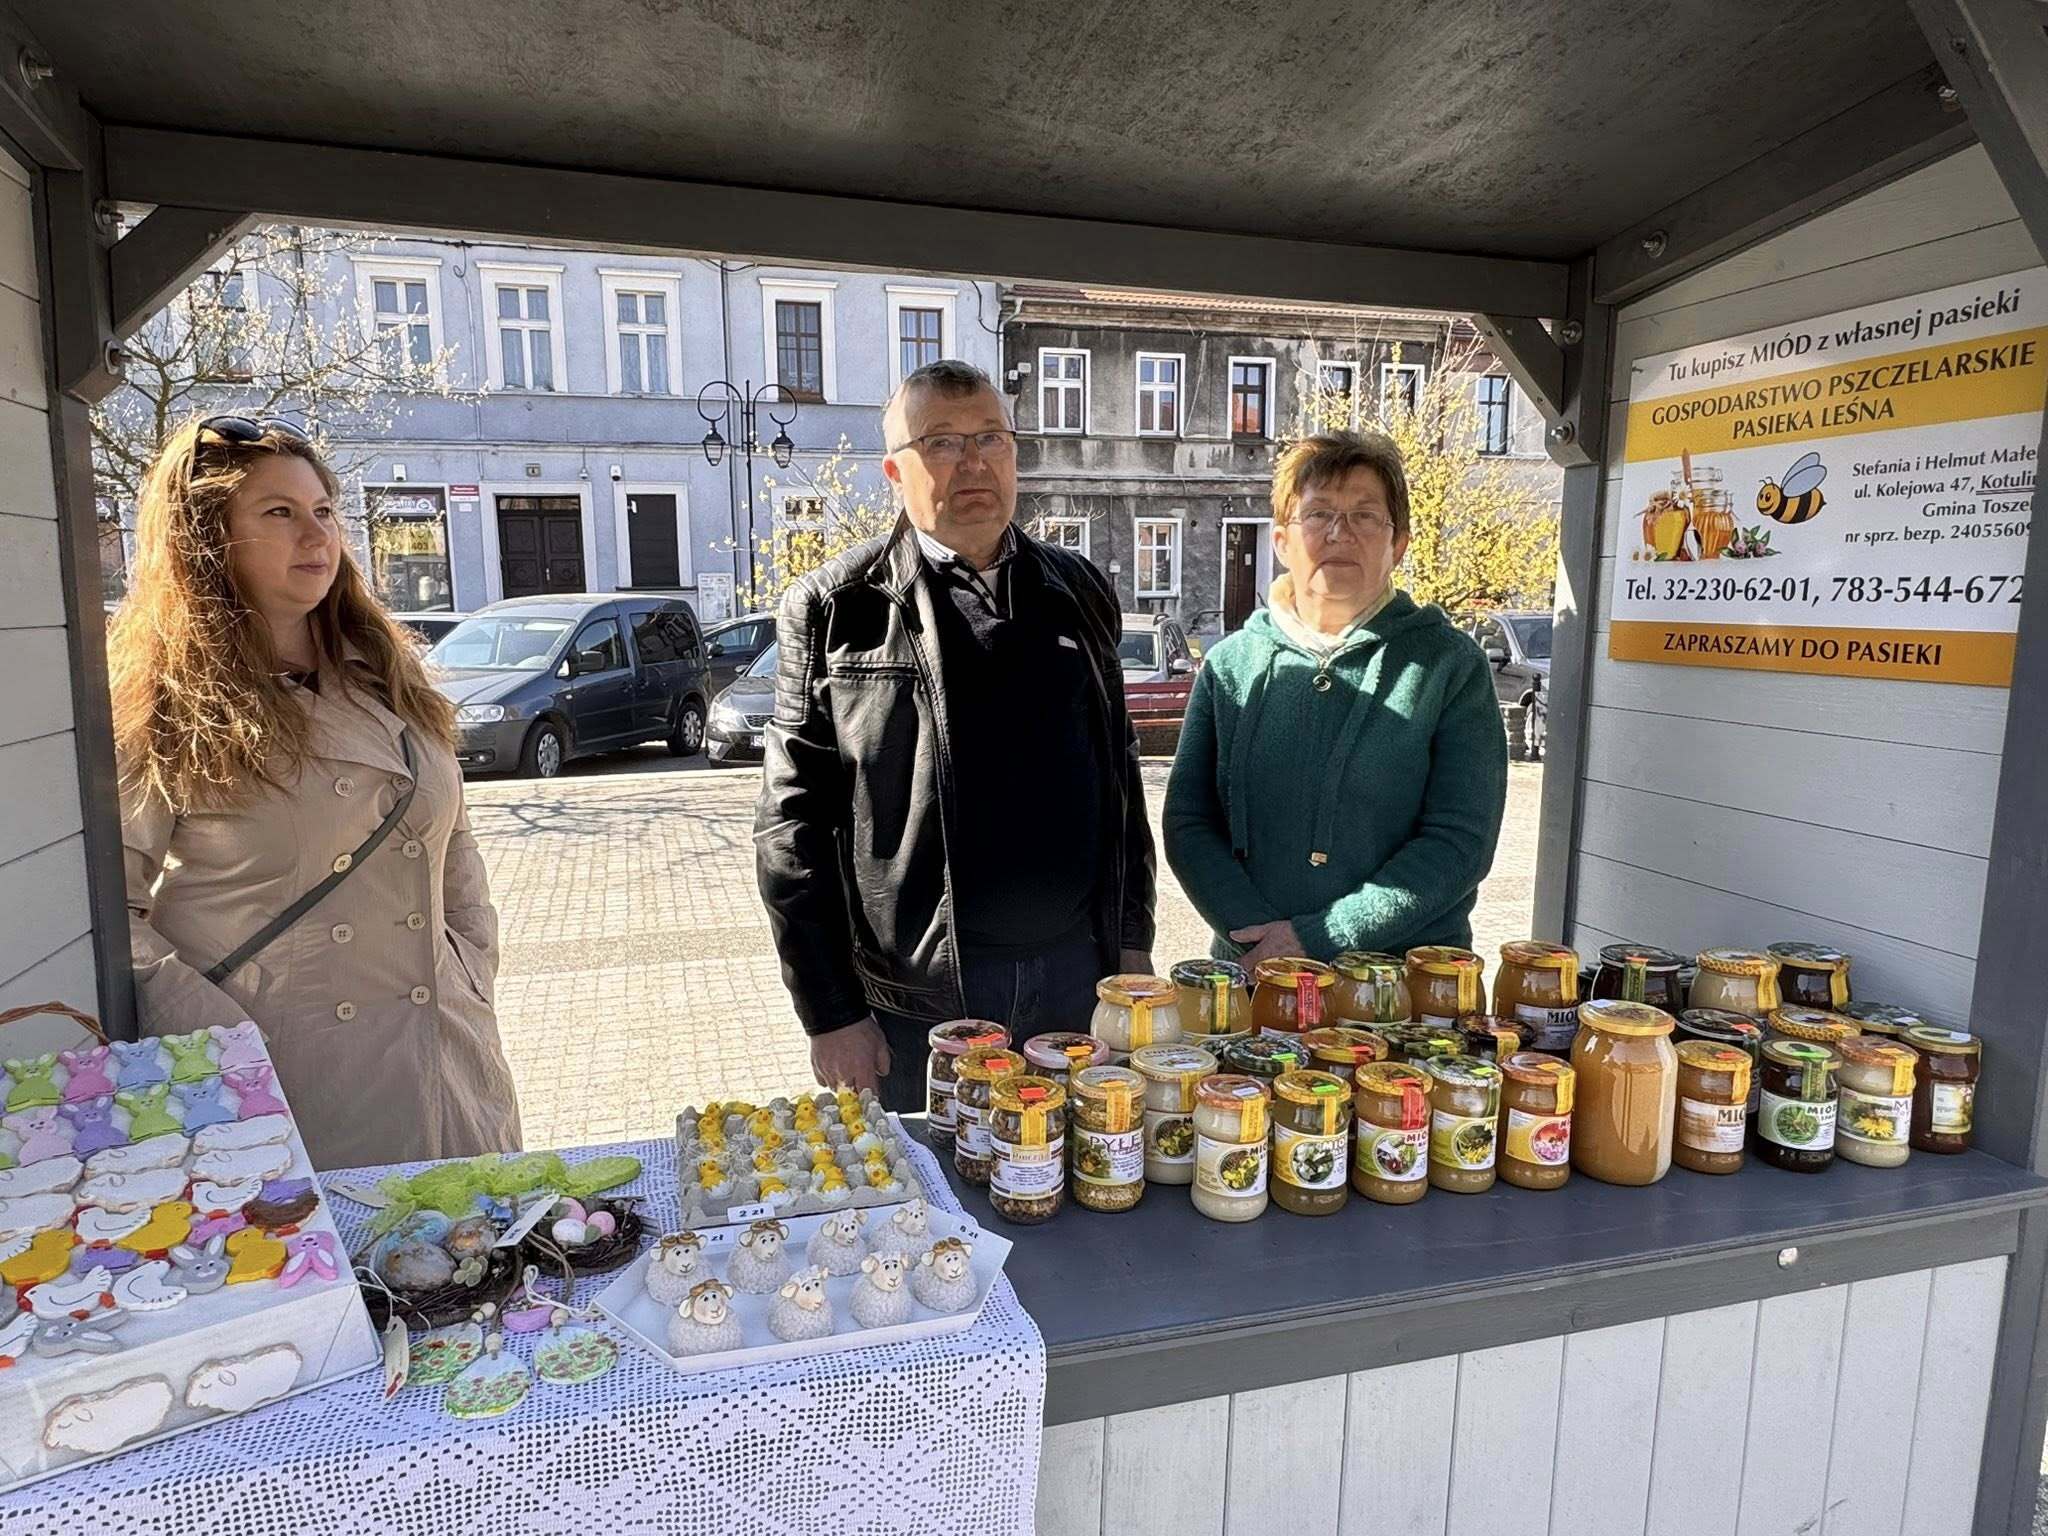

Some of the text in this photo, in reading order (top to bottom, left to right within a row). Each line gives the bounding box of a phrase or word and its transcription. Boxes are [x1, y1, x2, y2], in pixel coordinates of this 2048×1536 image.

[1669, 288, 2020, 381] Tu kupisz MIÓD z własnej pasieki
[1652, 341, 2036, 425] GOSPODARSTWO PSZCZELARSKIE
[1732, 396, 1895, 439] PASIEKA LEŚNA
[1852, 445, 2038, 477] Stefania i Helmut Małe
[1854, 484, 1871, 498] ul.
[1876, 481, 1944, 499] Kolejowa
[1950, 477, 1975, 494] 47,
[1922, 499, 2032, 517] Gmina Tosze
[1845, 532, 1860, 543] nr
[1864, 530, 1899, 546] sprz.
[1903, 526, 1945, 544] bezp.
[1626, 575, 2024, 607] Tel. 32-230-62-01, 783-544-672
[1664, 633, 1942, 665] ZAPRASZAMY DO PASIEKI
